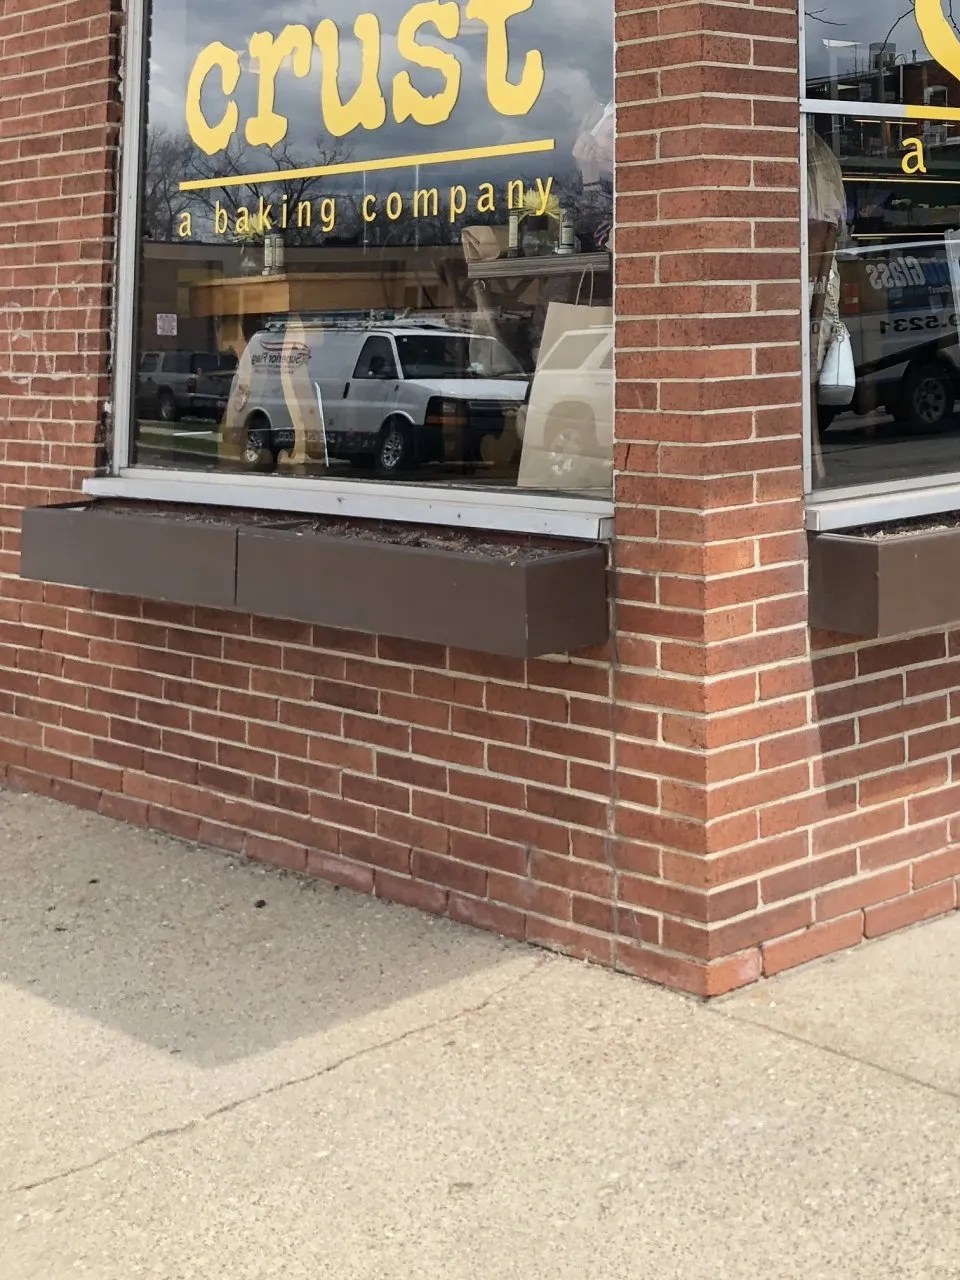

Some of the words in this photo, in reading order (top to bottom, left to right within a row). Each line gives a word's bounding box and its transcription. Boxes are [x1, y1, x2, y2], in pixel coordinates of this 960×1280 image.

[901, 137, 927, 174] a
[178, 213, 192, 237] a
[214, 194, 337, 234] baking
[362, 177, 554, 223] company
